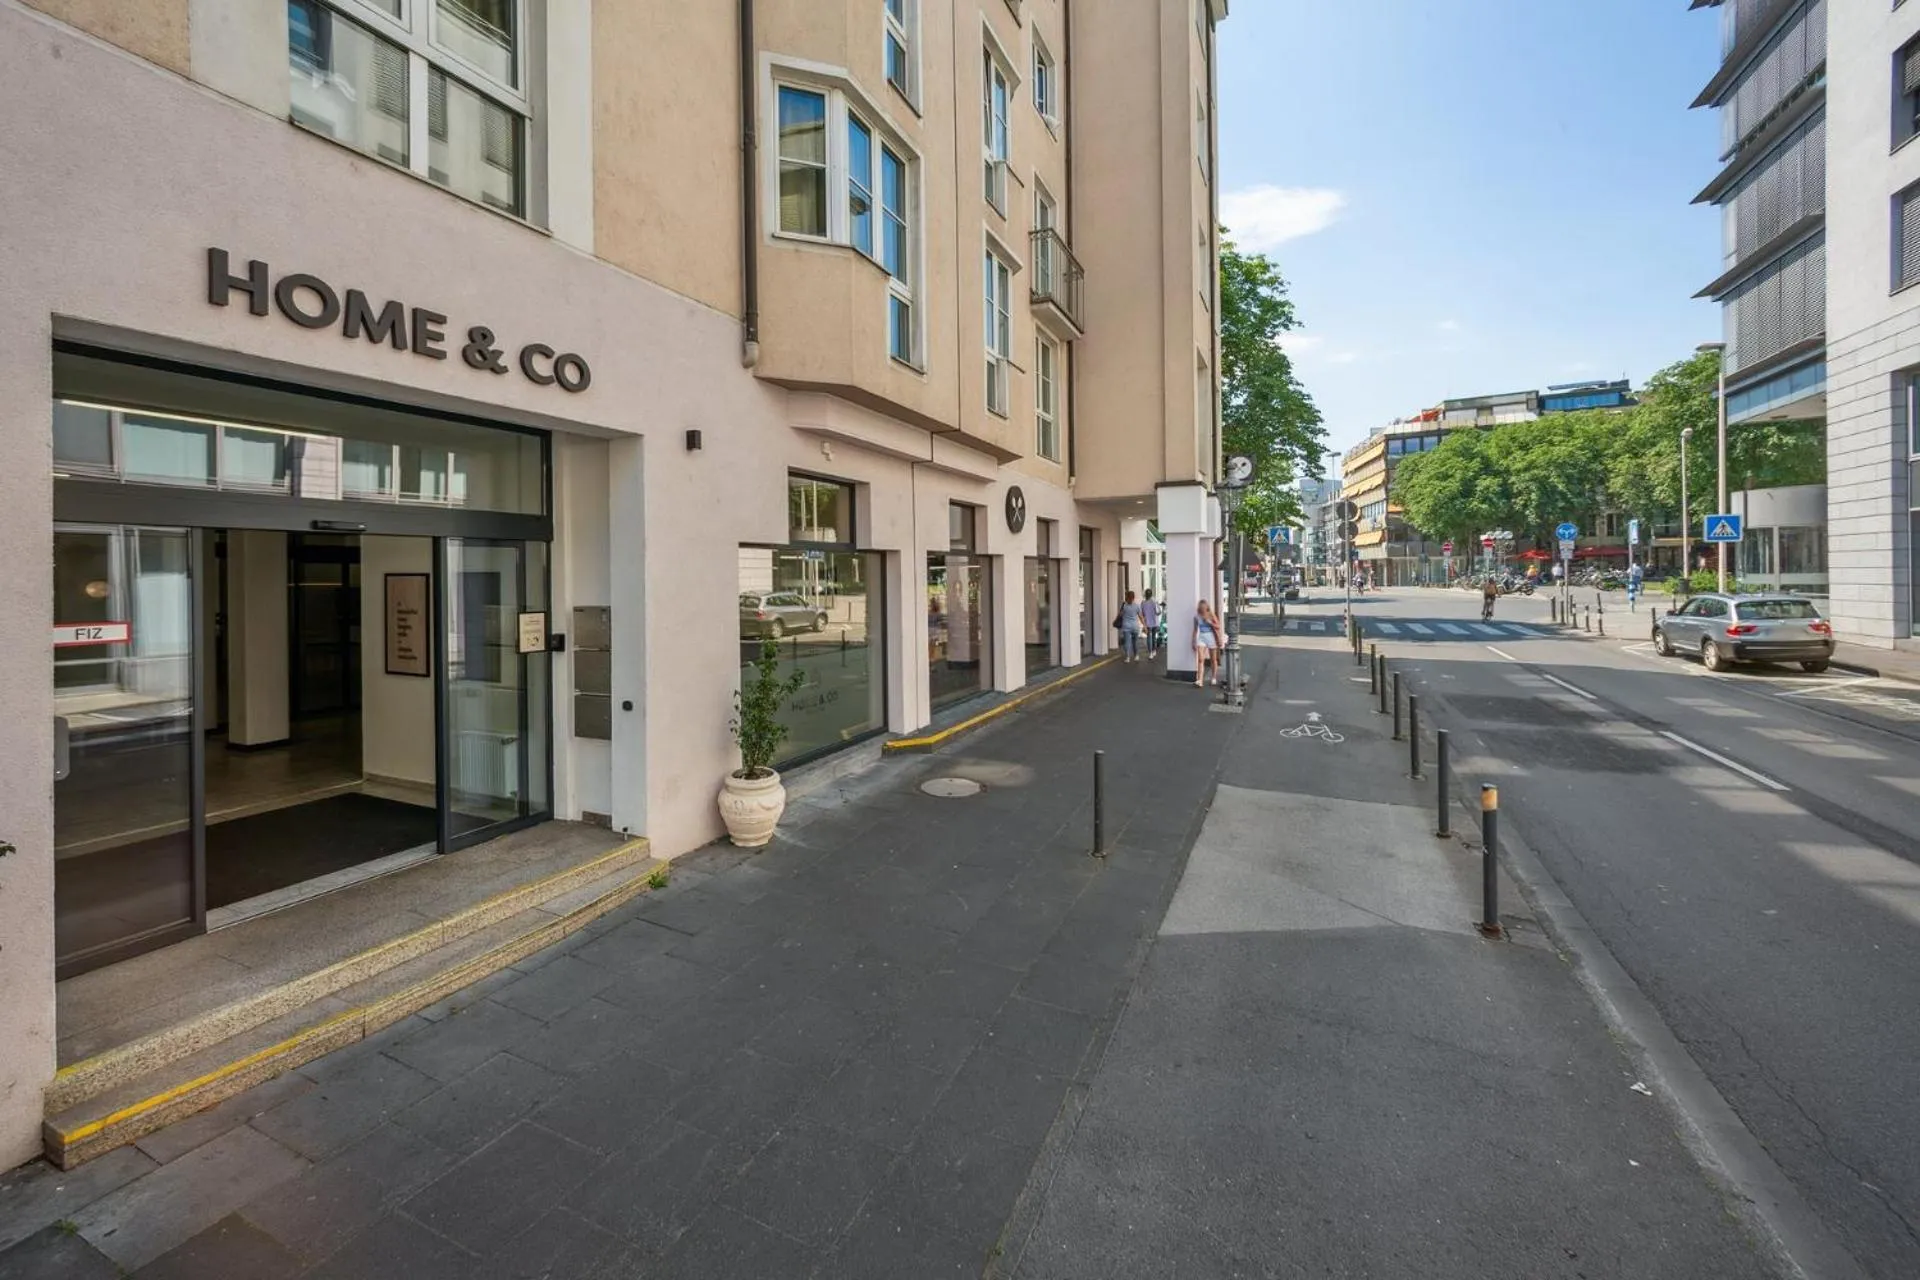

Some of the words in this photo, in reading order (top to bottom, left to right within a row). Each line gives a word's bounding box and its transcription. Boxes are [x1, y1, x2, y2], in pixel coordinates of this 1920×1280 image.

[208, 247, 447, 360] HOME
[462, 326, 509, 375] &
[520, 343, 591, 393] CO
[75, 627, 103, 640] FIZ
